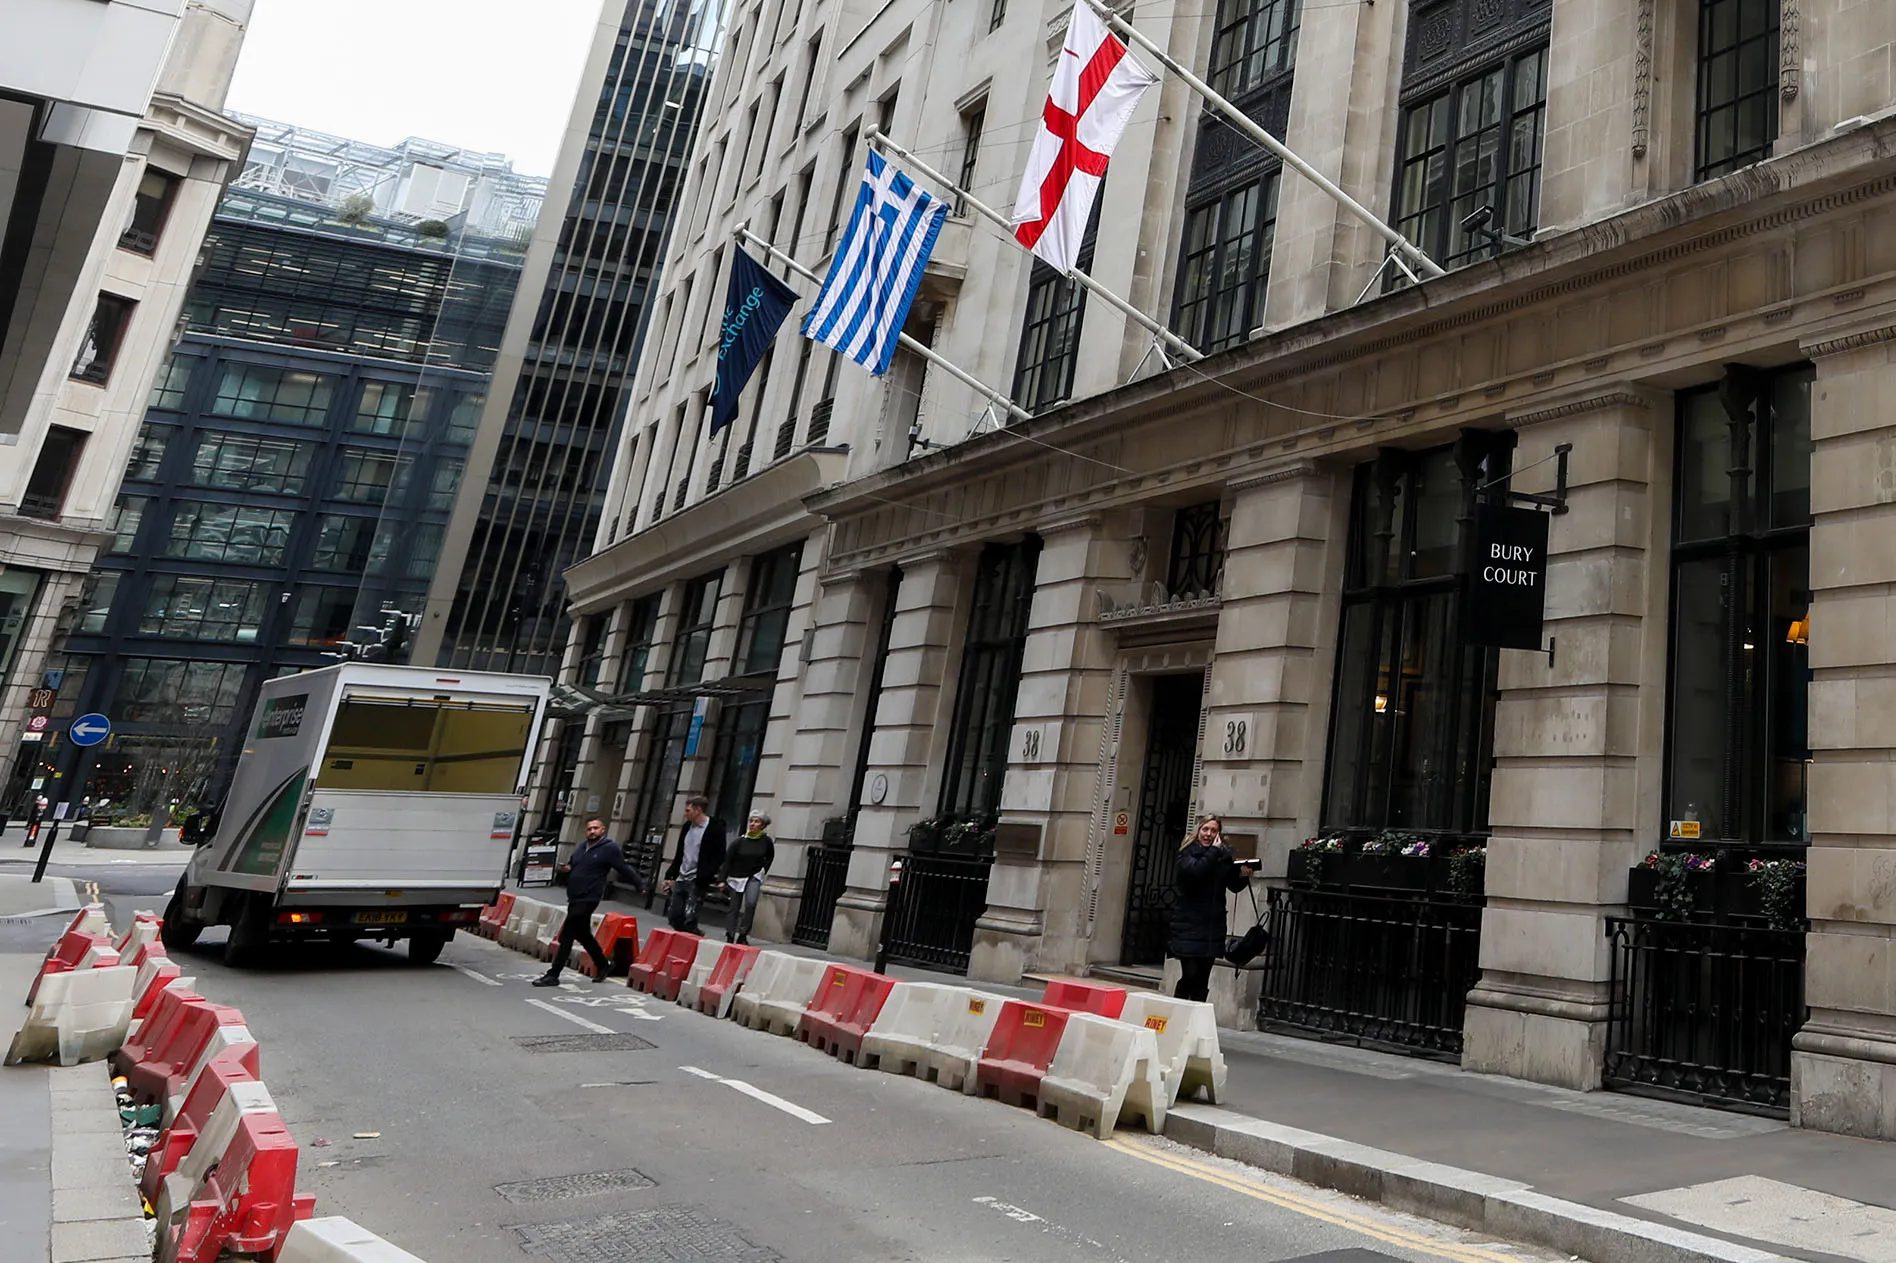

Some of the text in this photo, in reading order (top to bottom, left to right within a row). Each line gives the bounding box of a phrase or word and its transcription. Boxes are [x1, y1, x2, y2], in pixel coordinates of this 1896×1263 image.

[1490, 542, 1534, 562] BURY
[1483, 566, 1538, 587] COURT
[1022, 729, 1041, 758] 38
[1222, 720, 1247, 754] 38
